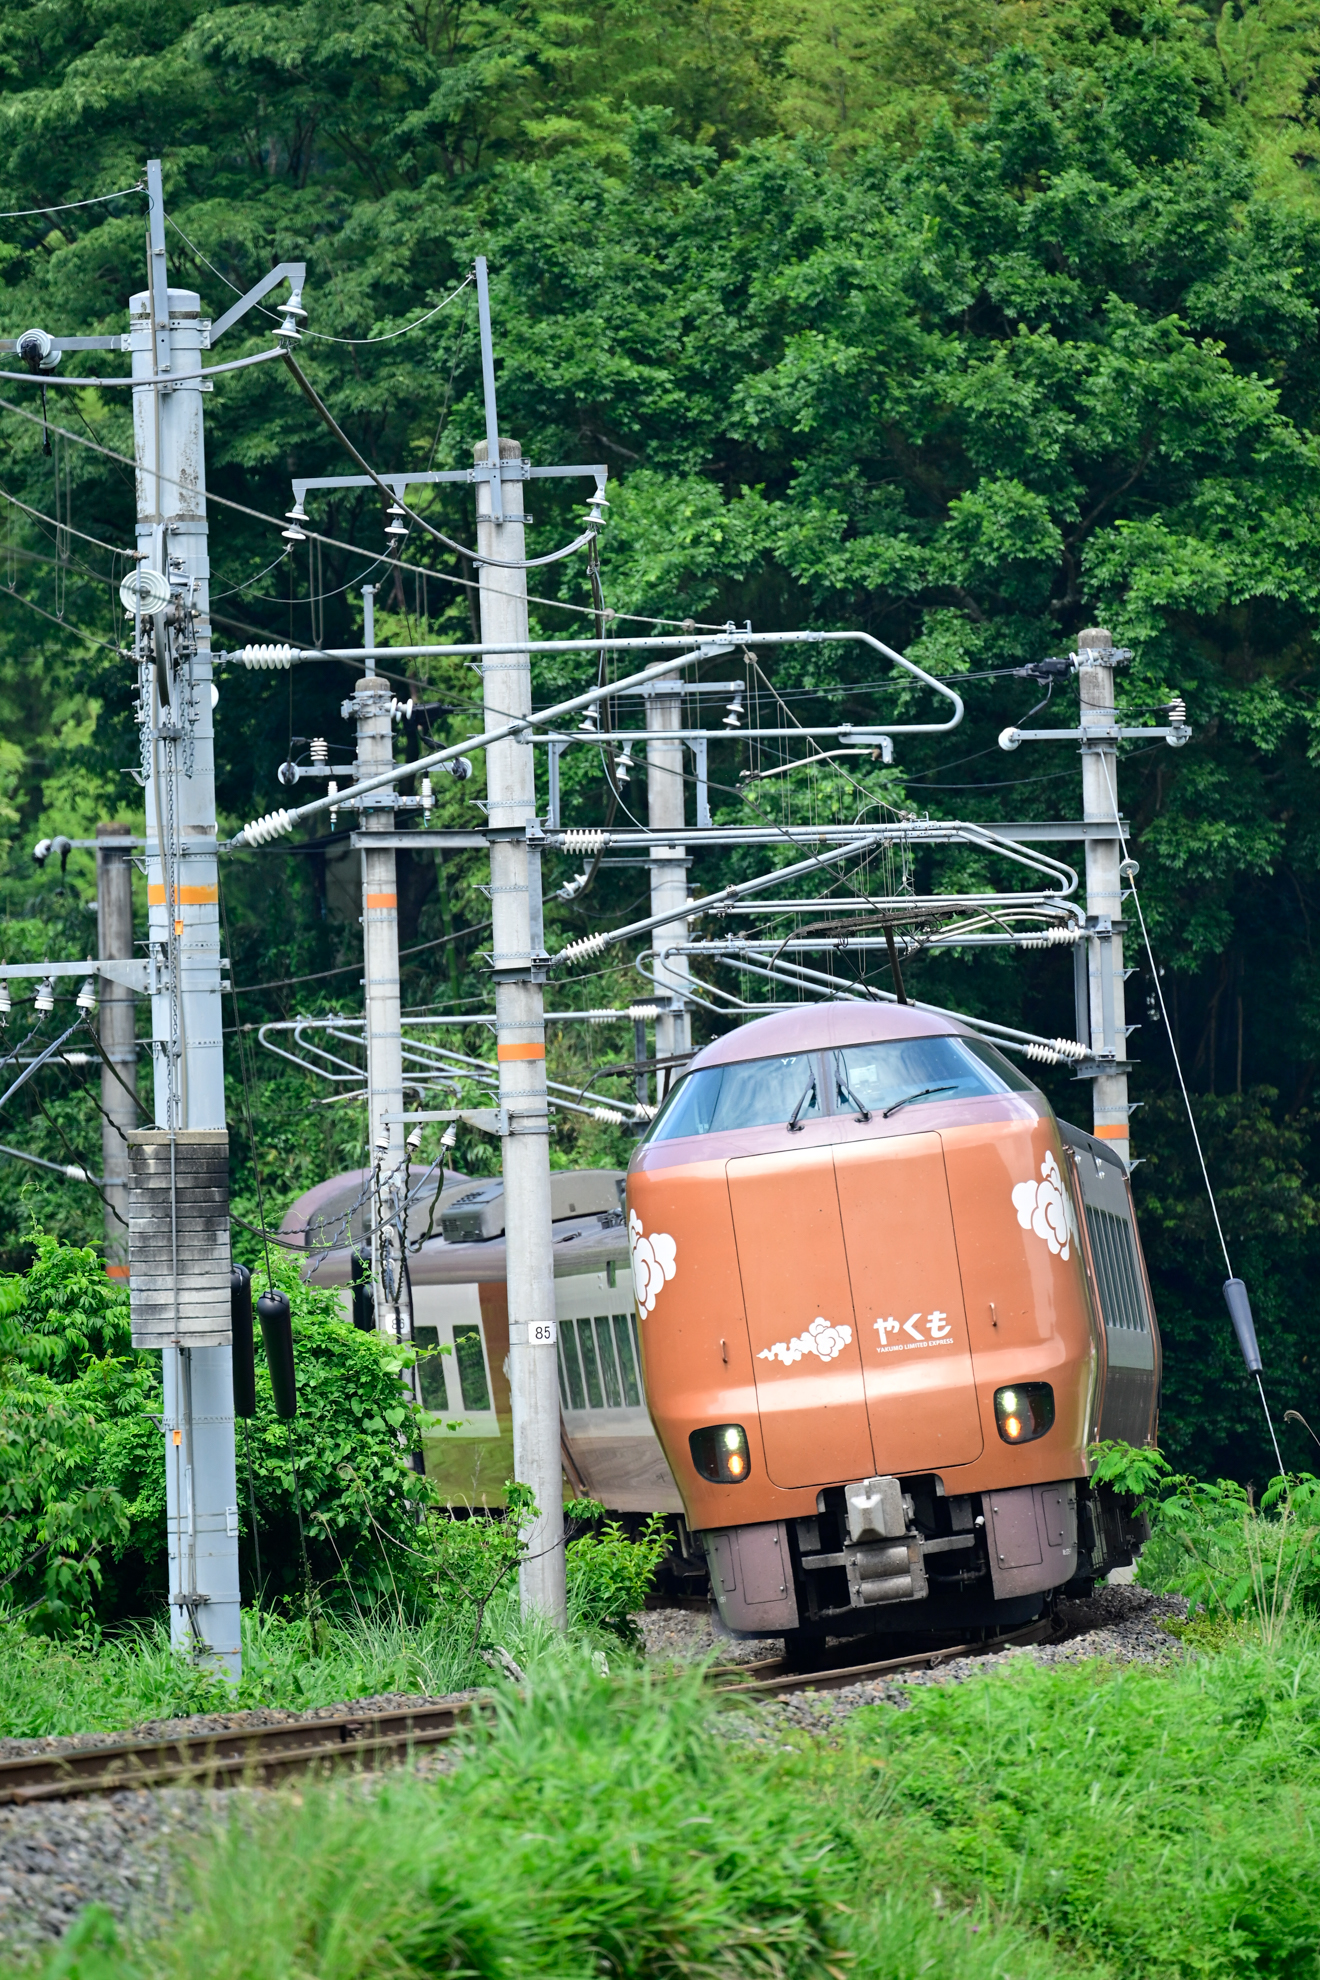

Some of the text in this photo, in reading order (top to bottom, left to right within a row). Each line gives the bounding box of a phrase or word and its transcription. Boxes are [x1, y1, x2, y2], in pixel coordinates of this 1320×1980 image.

[535, 1326, 551, 1339] 85
[873, 1310, 952, 1345] やくも
[876, 1338, 954, 1353] YAKUMO LIMITED EXPRESS
